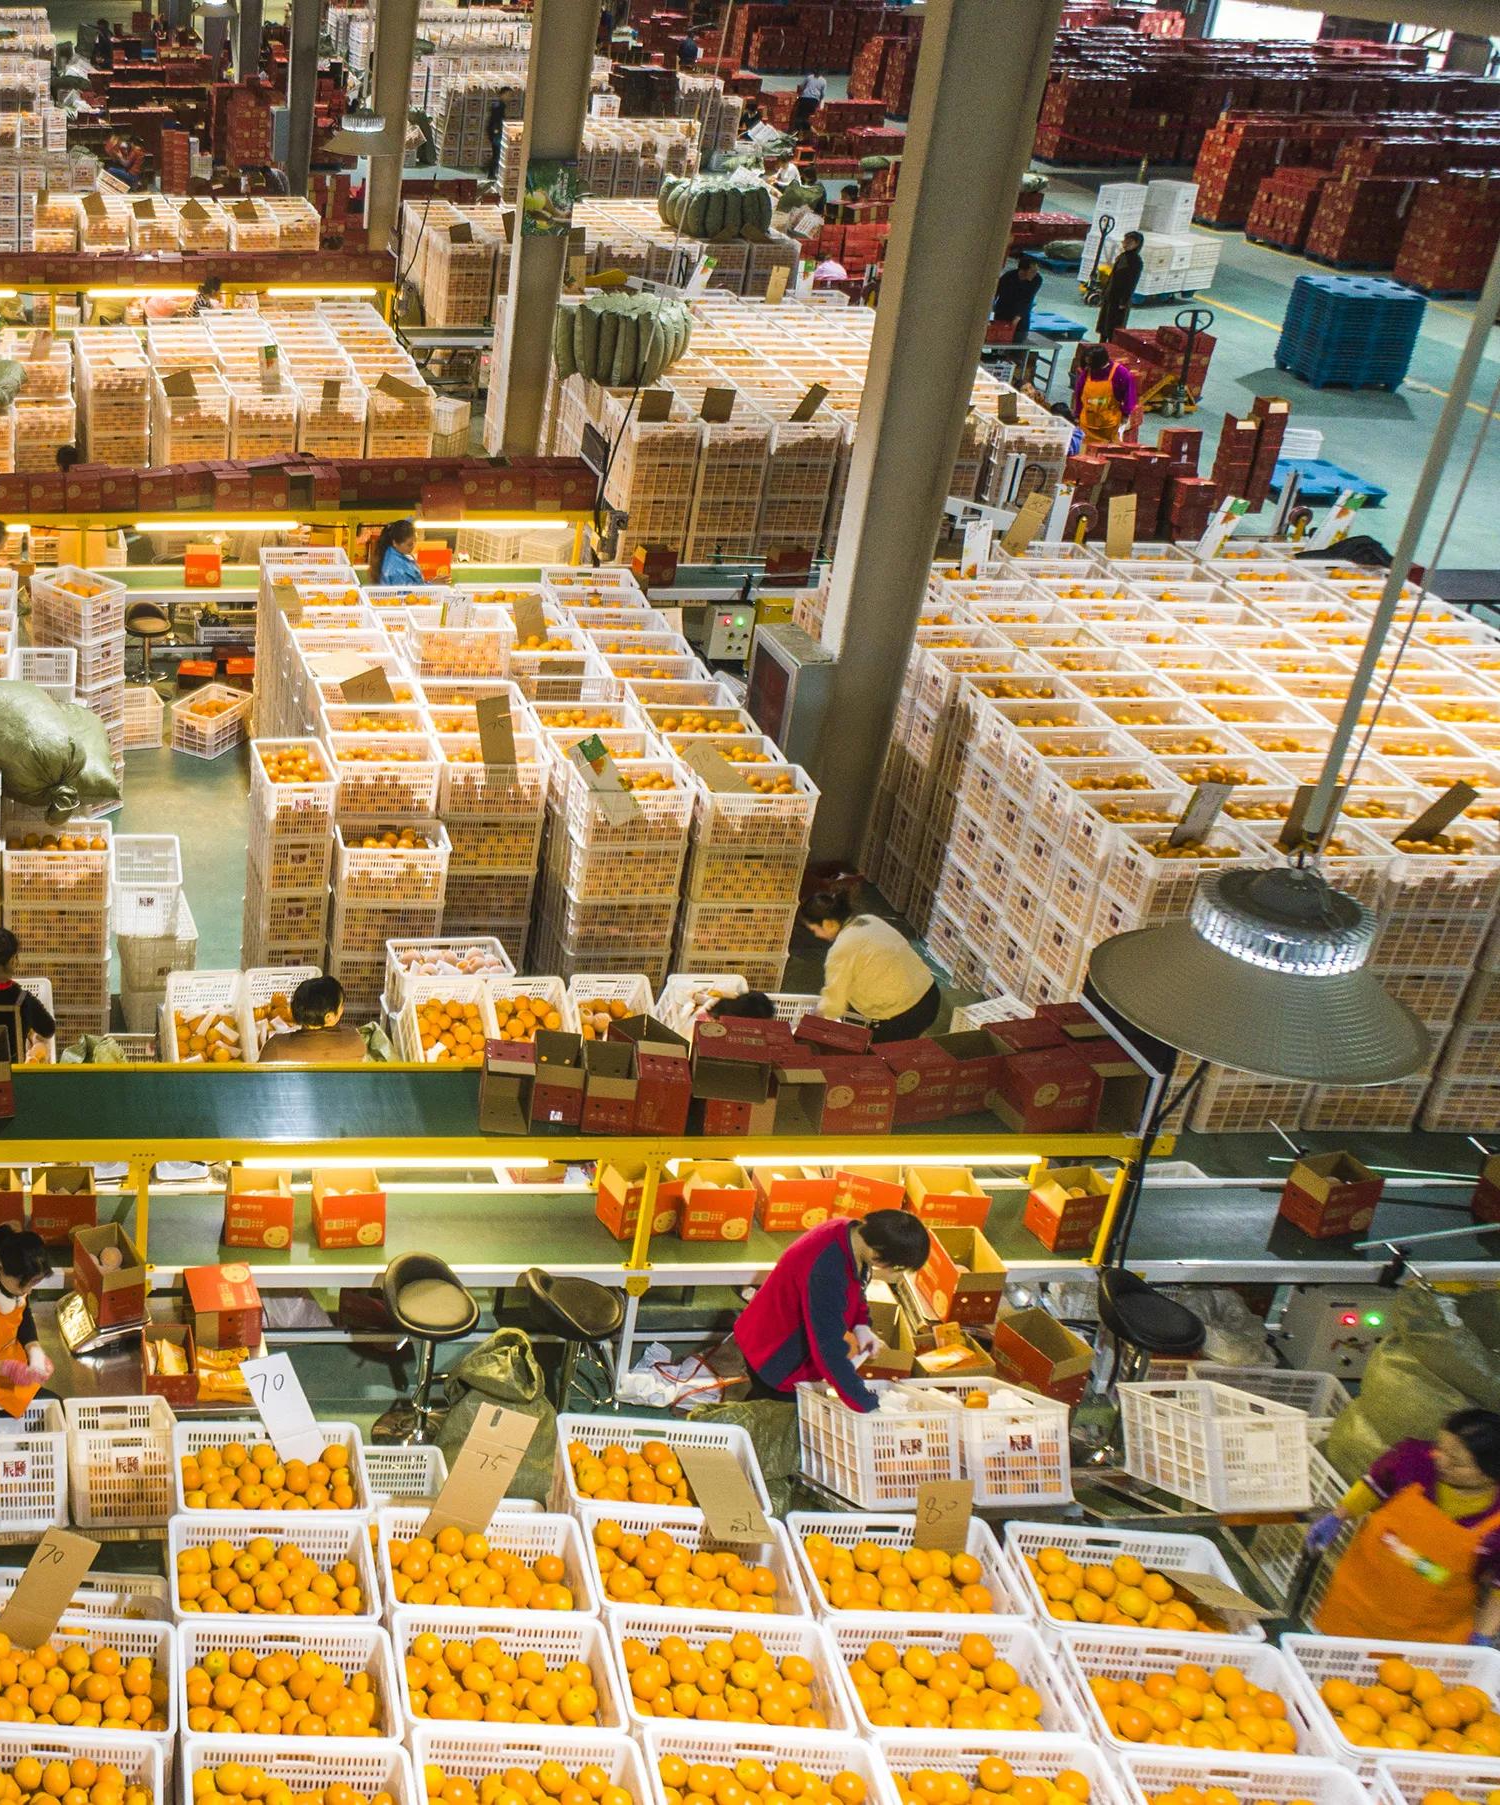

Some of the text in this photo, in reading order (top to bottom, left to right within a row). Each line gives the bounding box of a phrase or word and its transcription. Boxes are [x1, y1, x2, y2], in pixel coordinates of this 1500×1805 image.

[356, 679, 378, 698] 75
[692, 750, 711, 767] 70
[250, 1373, 284, 1403] 70
[476, 1450, 508, 1470] 75
[925, 1496, 958, 1525] 80
[38, 1543, 65, 1565] 70
